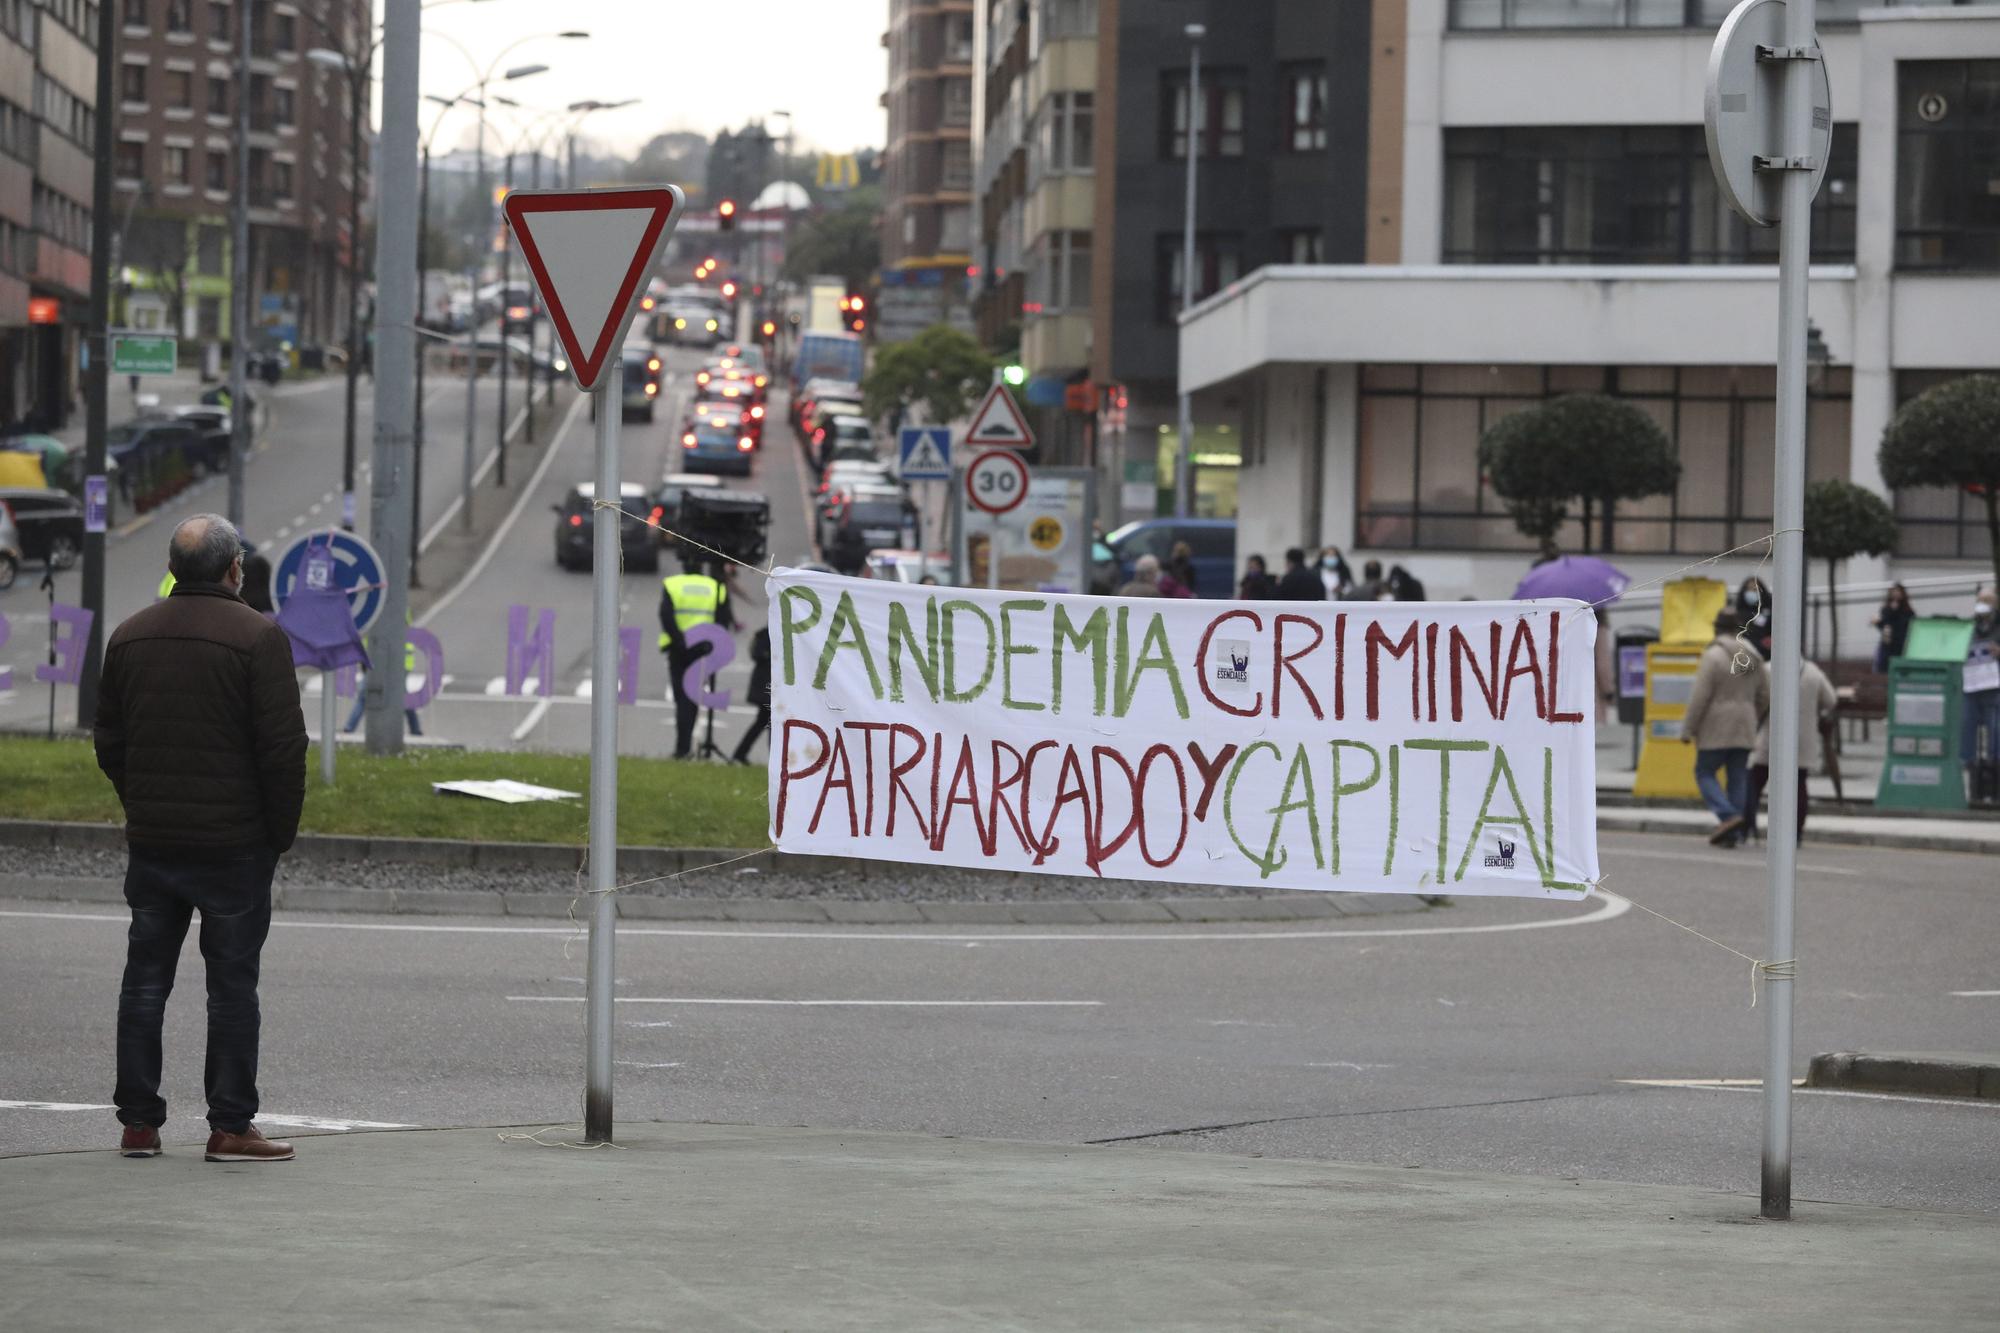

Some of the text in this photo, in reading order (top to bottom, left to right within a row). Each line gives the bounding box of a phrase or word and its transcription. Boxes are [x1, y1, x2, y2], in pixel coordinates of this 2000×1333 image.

[979, 471, 1016, 492] 30
[779, 586, 1190, 720] PANDEMIA
[1194, 609, 1585, 722] CRIMINAL
[1217, 670, 1247, 680] ESENCIALES
[775, 719, 1588, 891] PATRIARCADO Y CAPITAL
[1485, 858, 1514, 867] ESENCIALES
